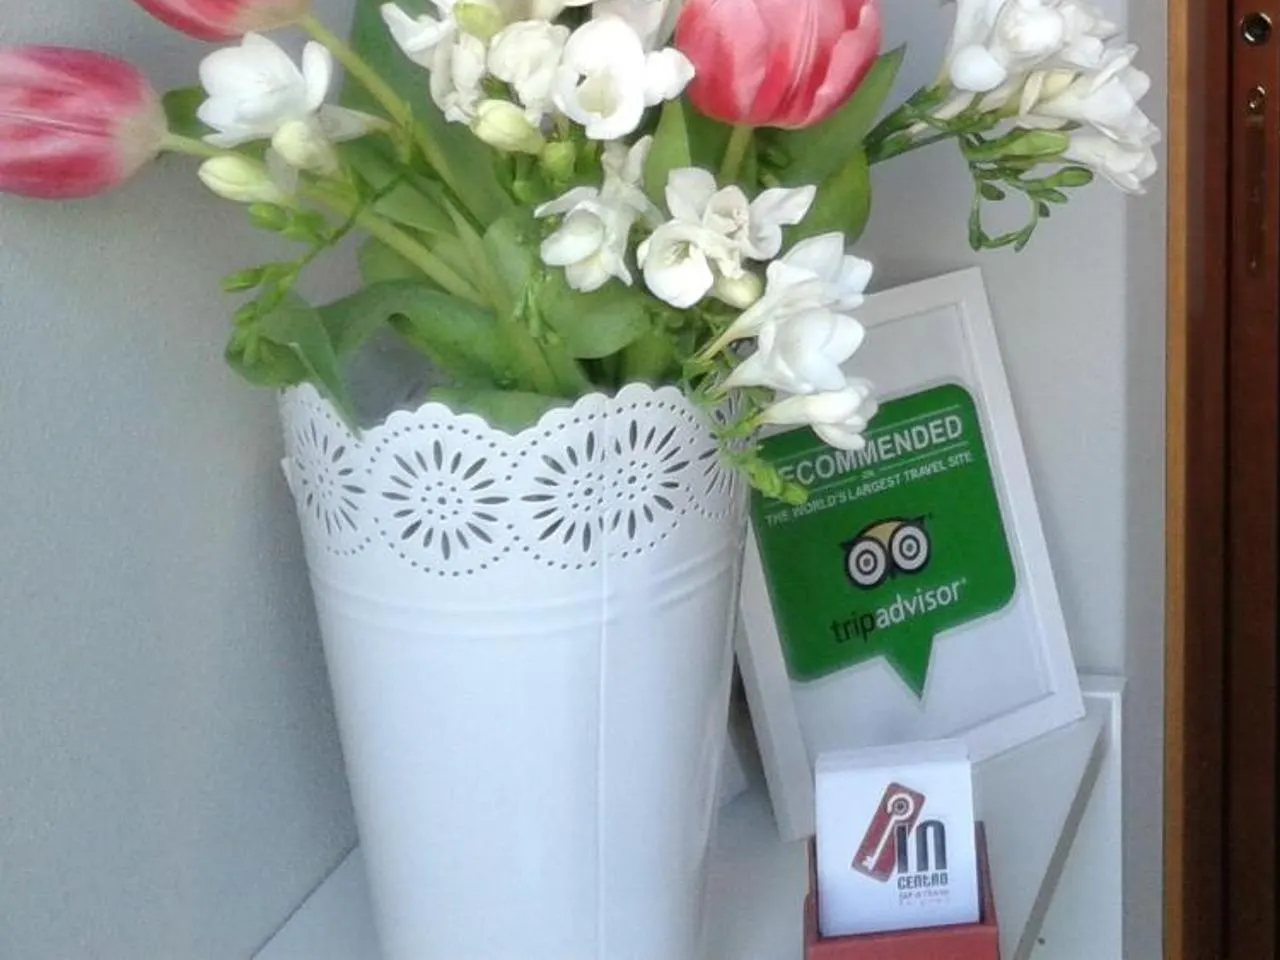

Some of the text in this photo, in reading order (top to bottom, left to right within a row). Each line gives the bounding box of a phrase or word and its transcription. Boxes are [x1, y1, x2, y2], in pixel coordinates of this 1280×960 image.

[778, 415, 962, 485] ECOMMENDED
[766, 513, 790, 527] THE
[848, 474, 900, 500] LARGEST
[903, 460, 946, 482] TRAVEL
[830, 587, 961, 644] tripadvisor
